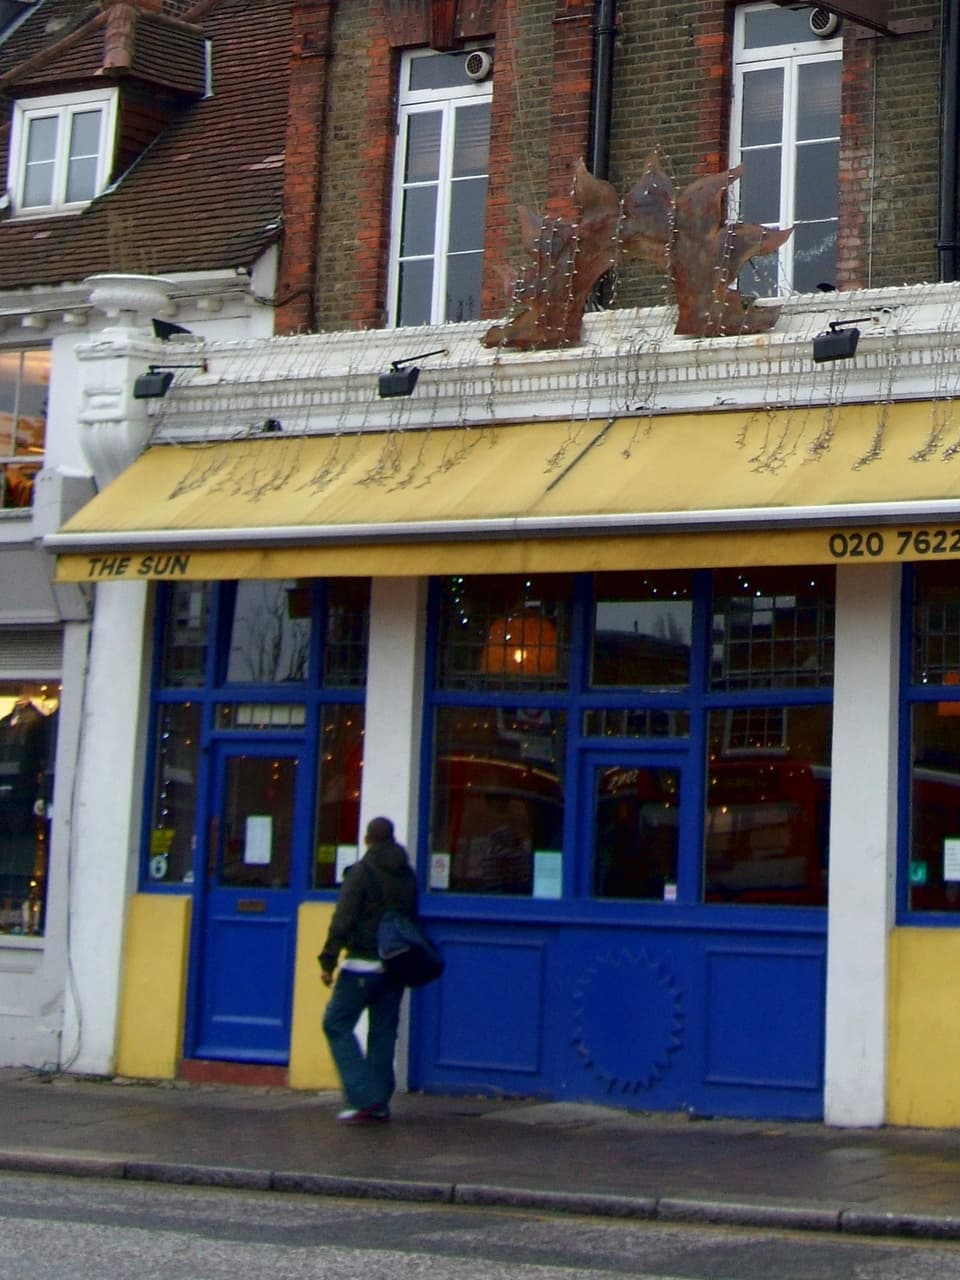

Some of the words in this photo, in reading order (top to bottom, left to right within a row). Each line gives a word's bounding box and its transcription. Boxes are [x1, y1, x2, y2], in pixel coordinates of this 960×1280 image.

[828, 532, 884, 558] 020
[88, 557, 132, 577] THE
[137, 554, 191, 575] SUN
